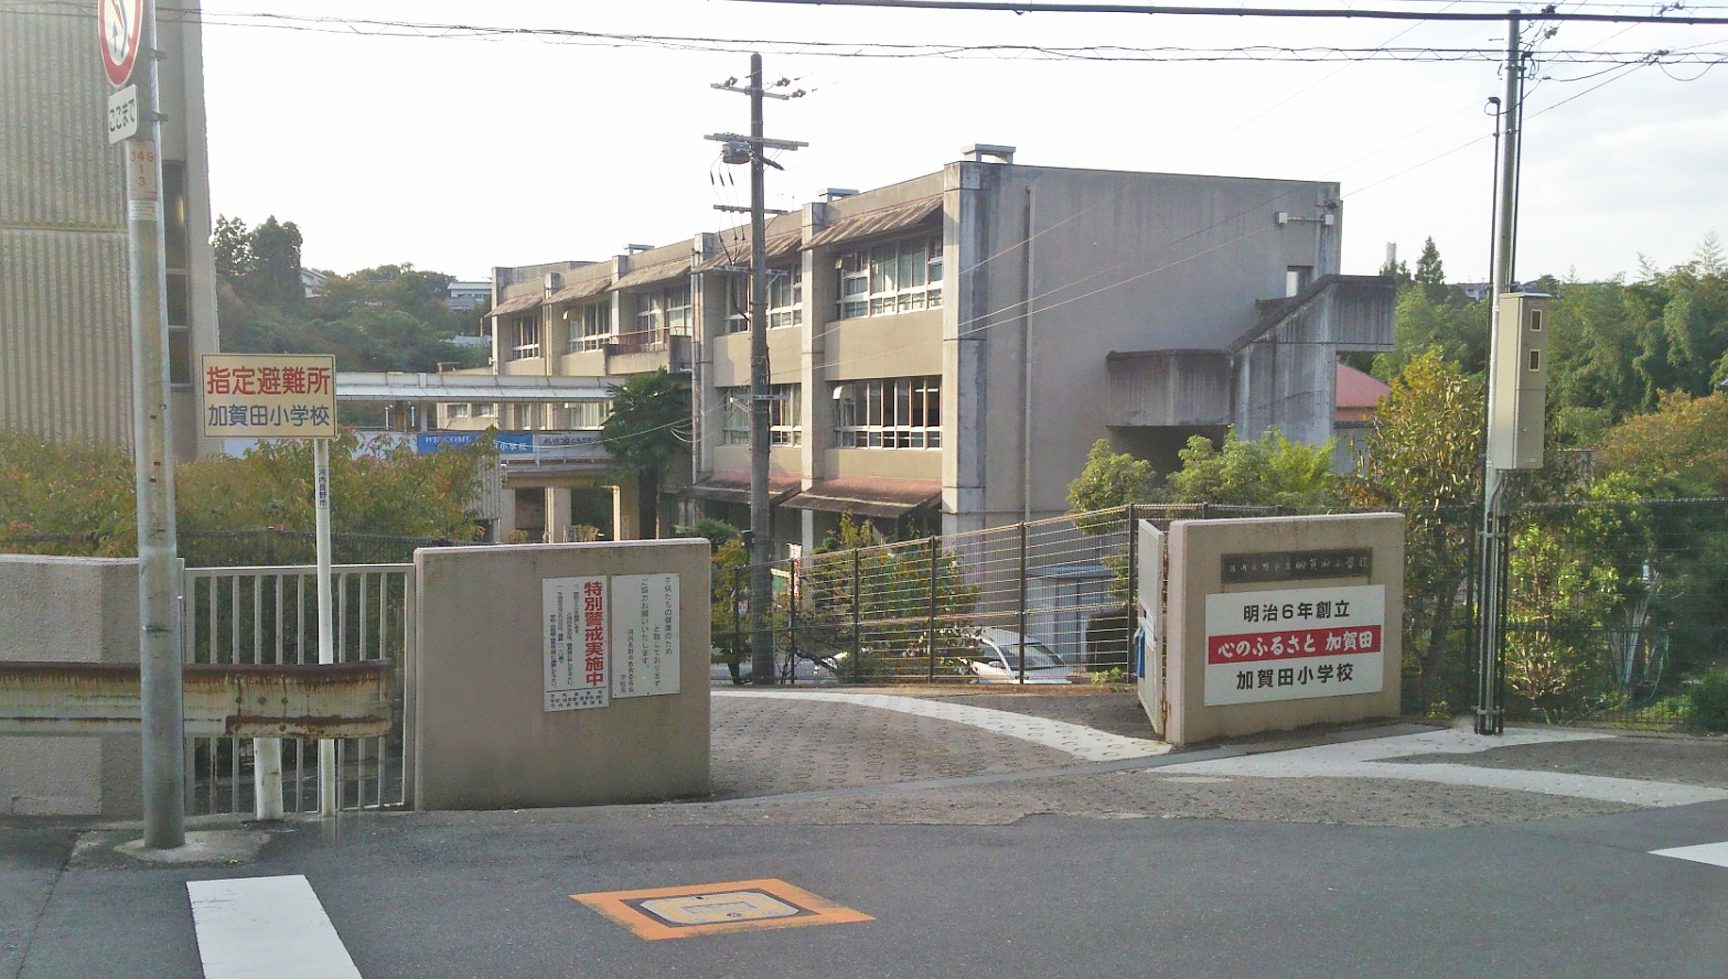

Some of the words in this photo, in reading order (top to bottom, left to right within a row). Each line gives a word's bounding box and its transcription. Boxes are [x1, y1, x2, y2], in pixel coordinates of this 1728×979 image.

[110, 99, 135, 132] ここまで
[138, 176, 146, 187] 3
[139, 164, 144, 174] 1
[207, 366, 331, 395] 指定避難所
[208, 404, 330, 427] 加賀田小学校
[1243, 600, 1350, 623] 明治6年創立
[584, 581, 604, 686] 特別警戒実施中
[1217, 634, 1317, 658] 心のふるさと
[1325, 630, 1373, 651] 加賀田
[1236, 663, 1354, 690] 加賀田小学校
